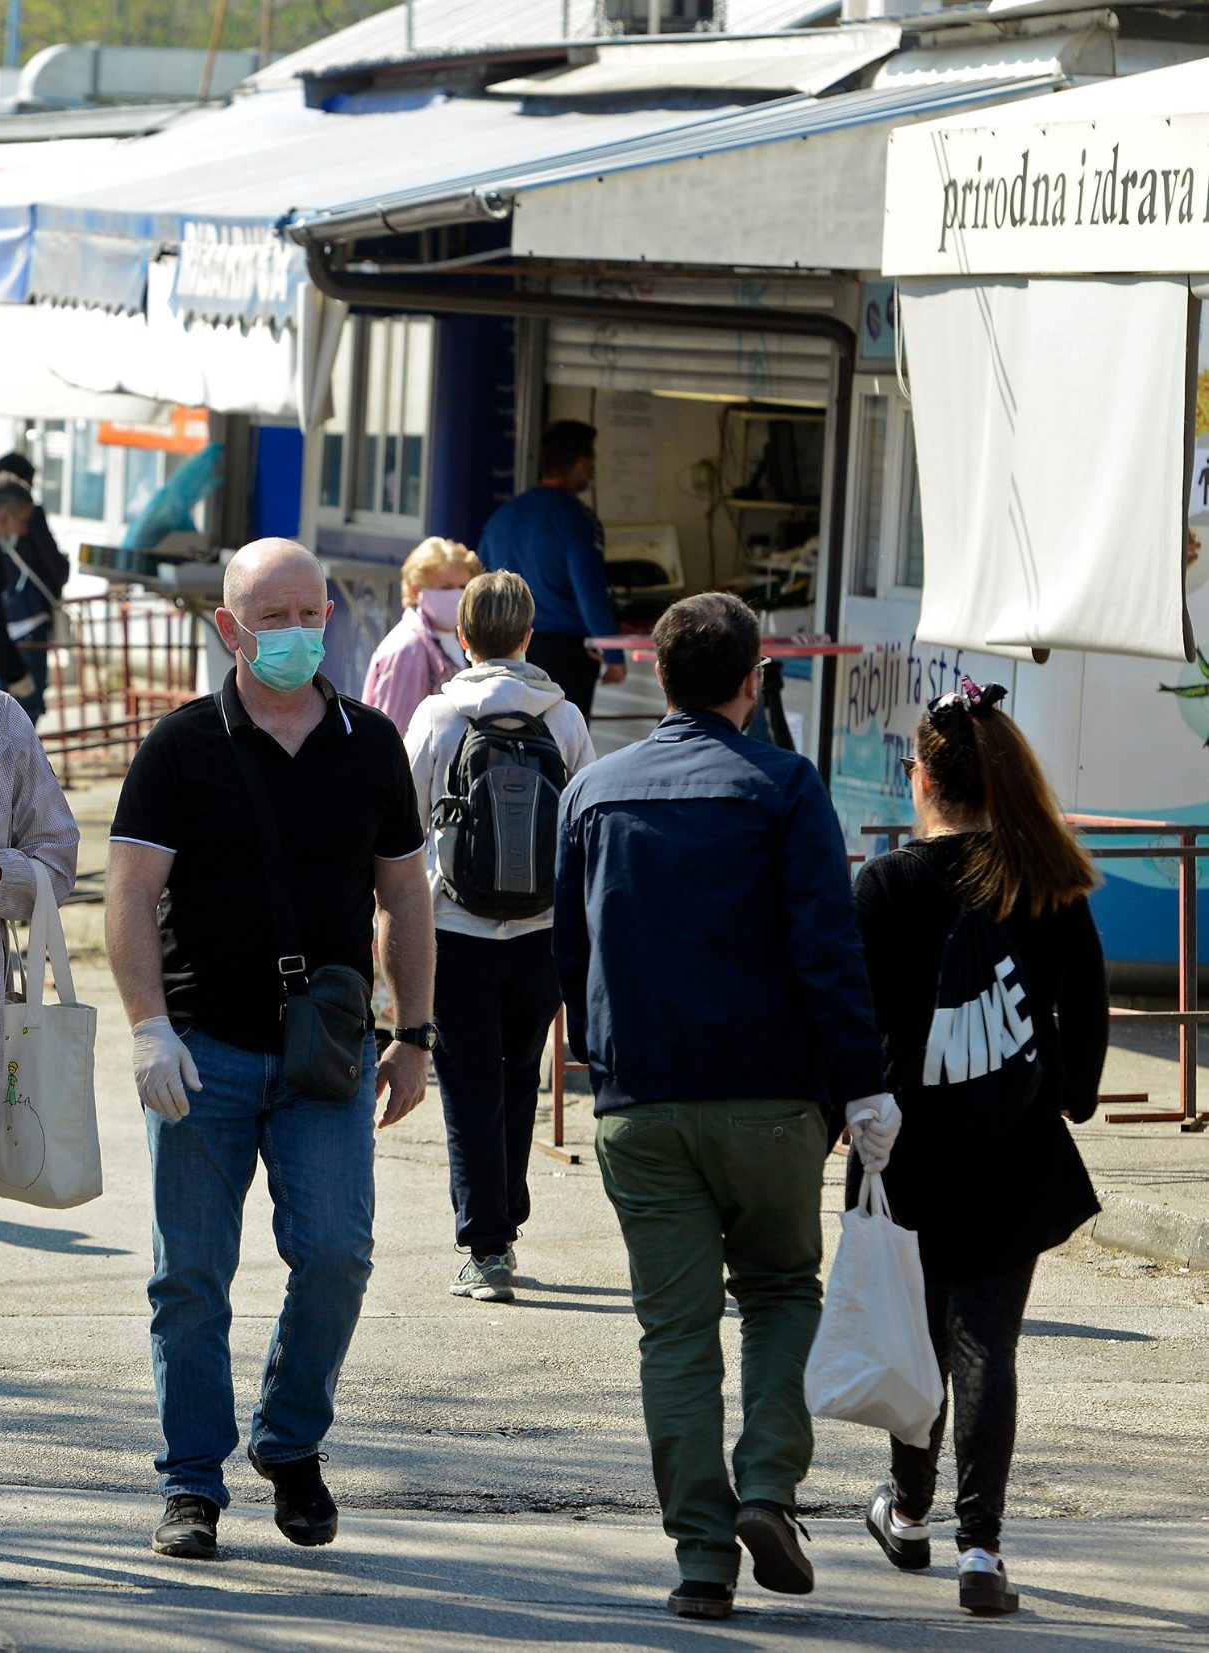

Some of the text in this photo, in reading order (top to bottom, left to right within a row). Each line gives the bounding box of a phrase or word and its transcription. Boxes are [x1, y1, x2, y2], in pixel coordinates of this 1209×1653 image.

[938, 148, 1067, 253] prirodna
[1074, 148, 1088, 226] i
[1089, 142, 1195, 226] zdrava
[922, 955, 1034, 1086] NIKE
